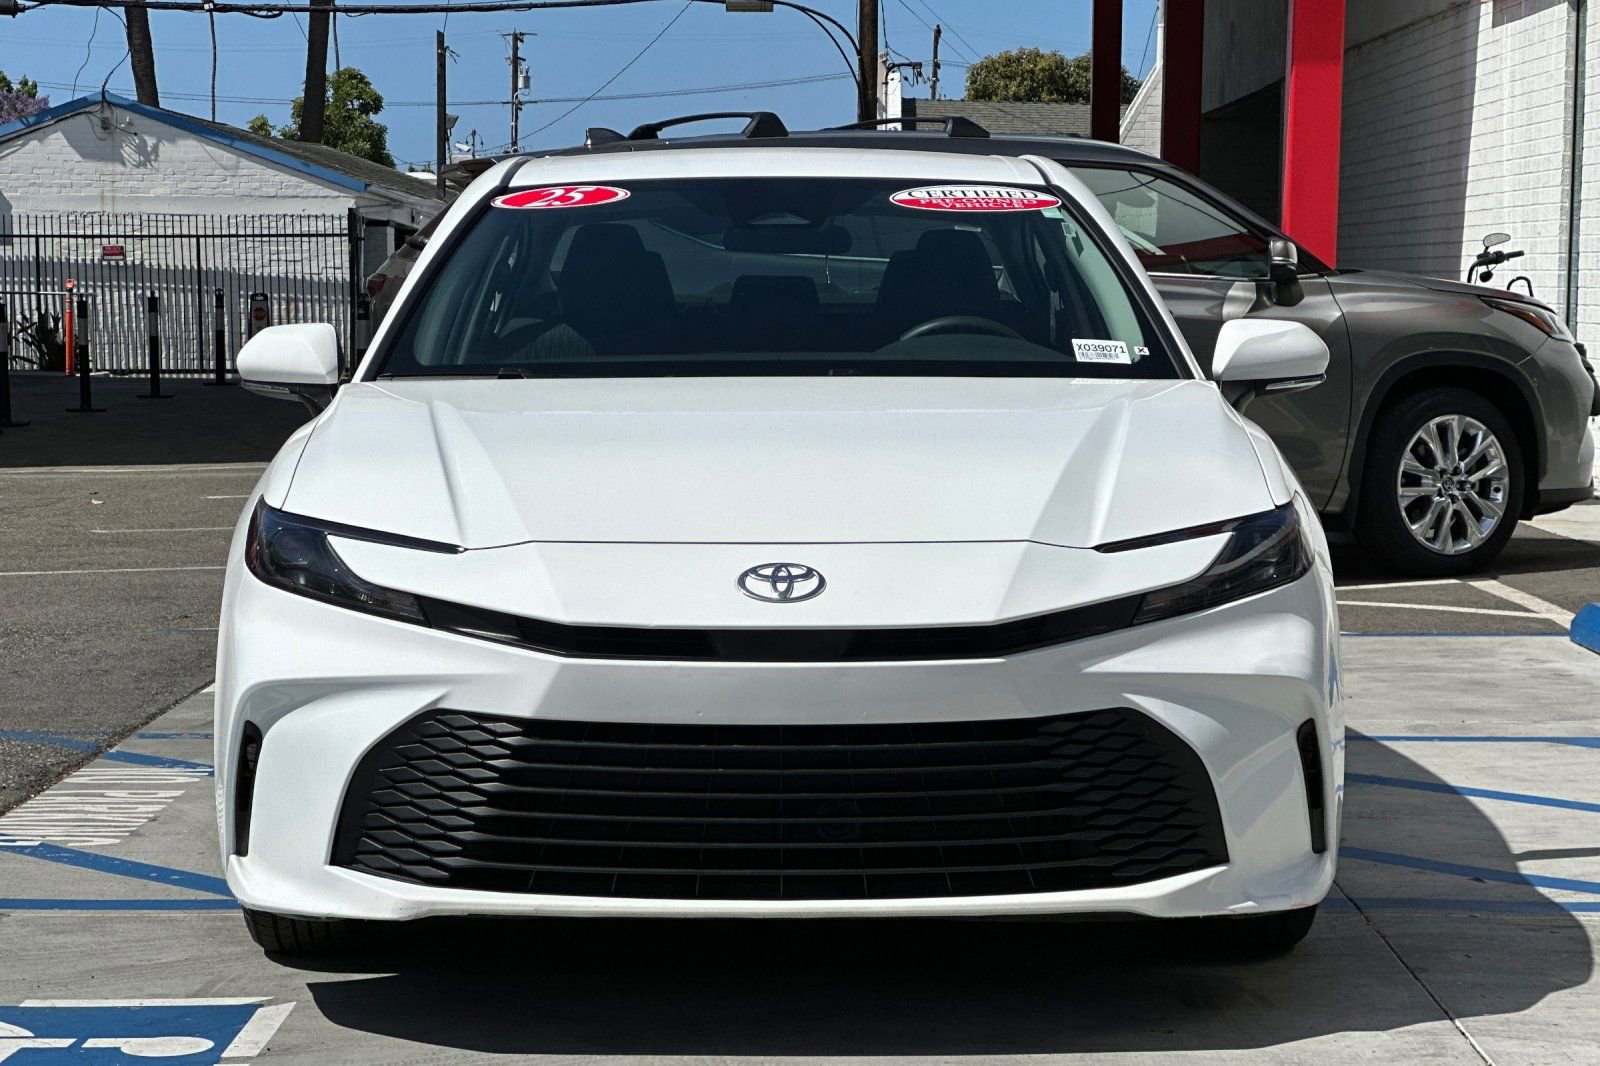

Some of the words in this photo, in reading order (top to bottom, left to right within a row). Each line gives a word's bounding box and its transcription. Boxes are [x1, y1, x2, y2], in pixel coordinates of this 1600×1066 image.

[523, 188, 595, 206] 25
[908, 189, 1038, 199] CERTIFIED
[1076, 343, 1126, 354] X039071
